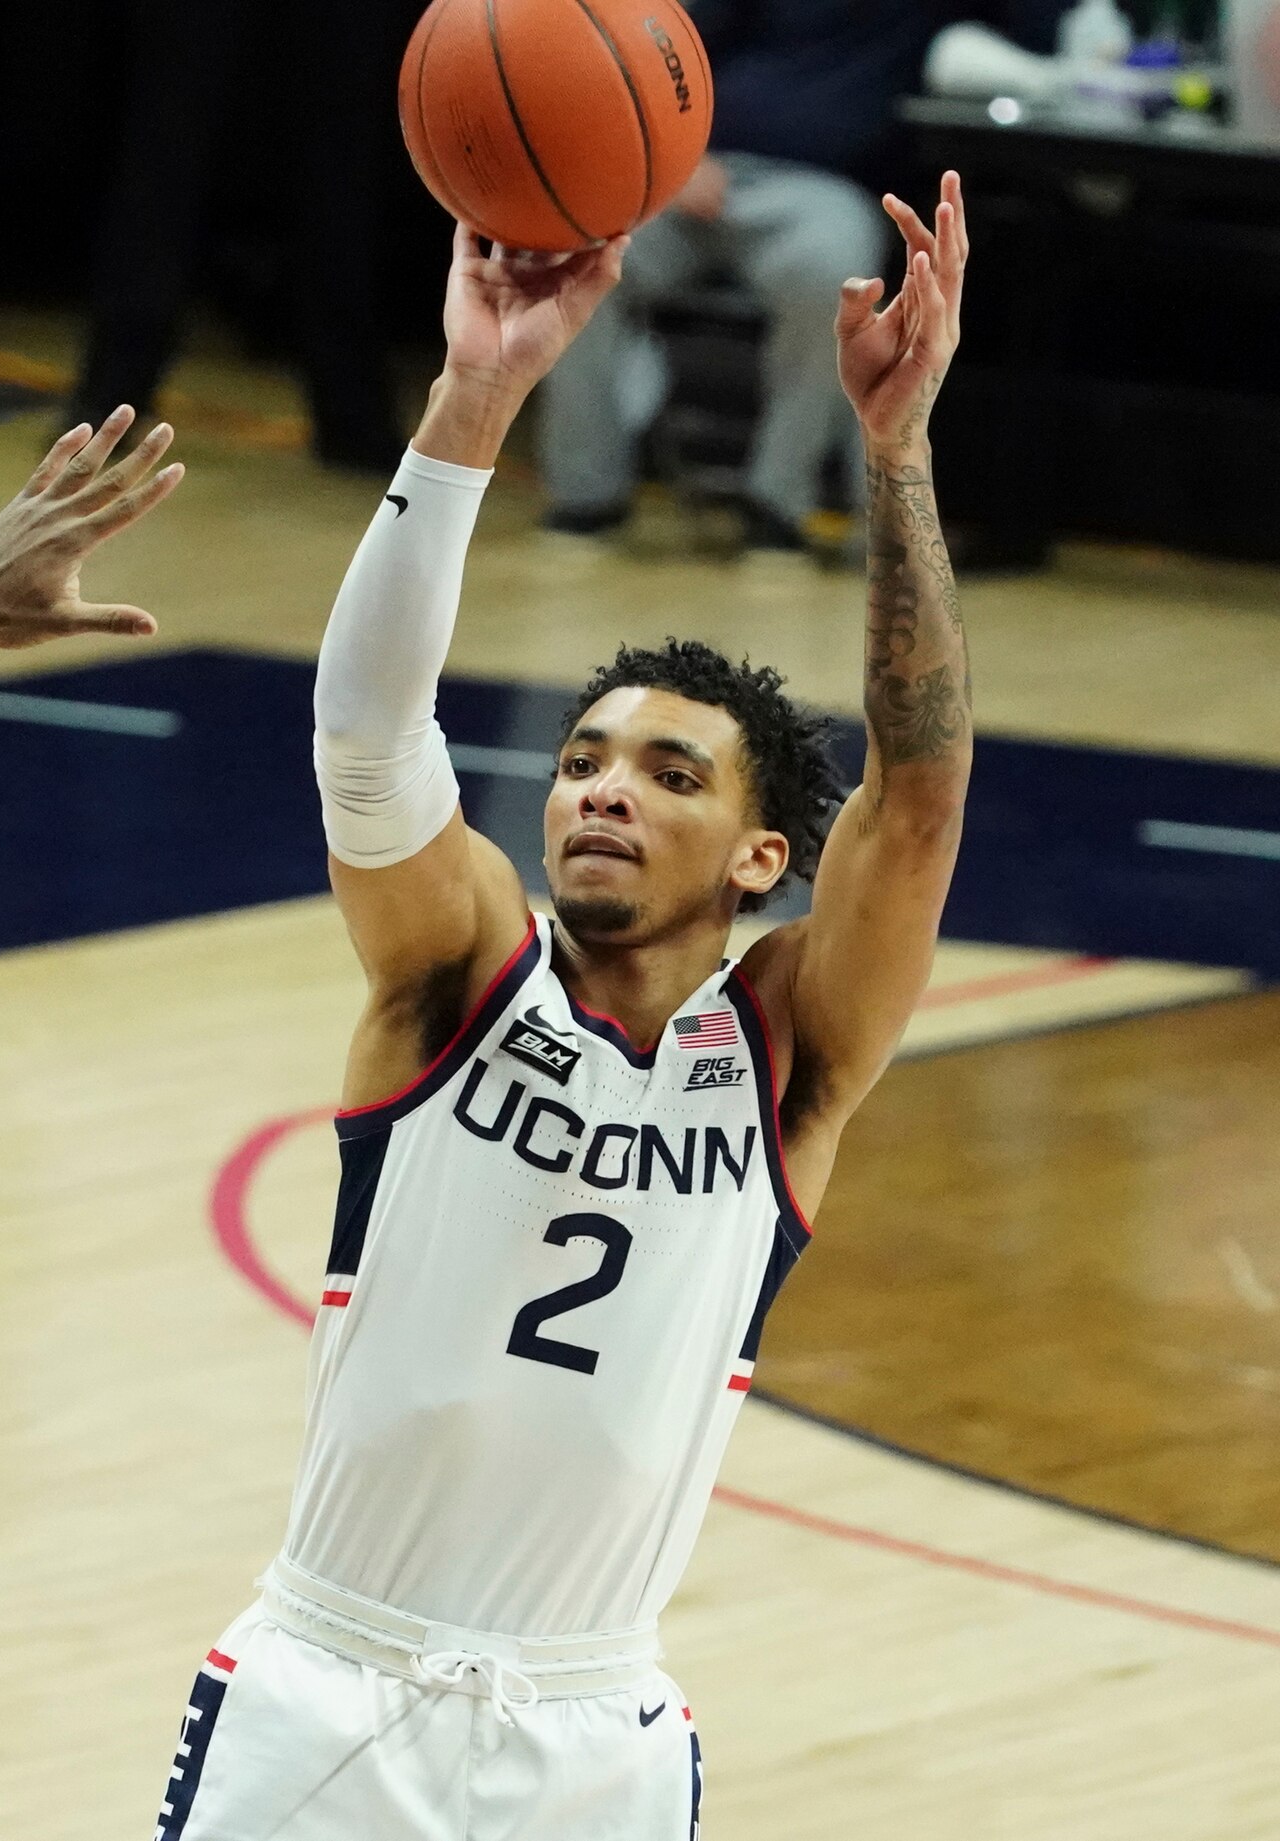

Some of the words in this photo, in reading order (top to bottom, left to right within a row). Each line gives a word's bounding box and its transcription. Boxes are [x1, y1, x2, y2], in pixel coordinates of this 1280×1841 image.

[644, 16, 692, 113] UCONN
[514, 1031, 574, 1067] BLM
[687, 1069, 748, 1085] EAST
[692, 1056, 735, 1072] BIG
[453, 1057, 757, 1195] UCONN
[506, 1212, 634, 1376] 2
